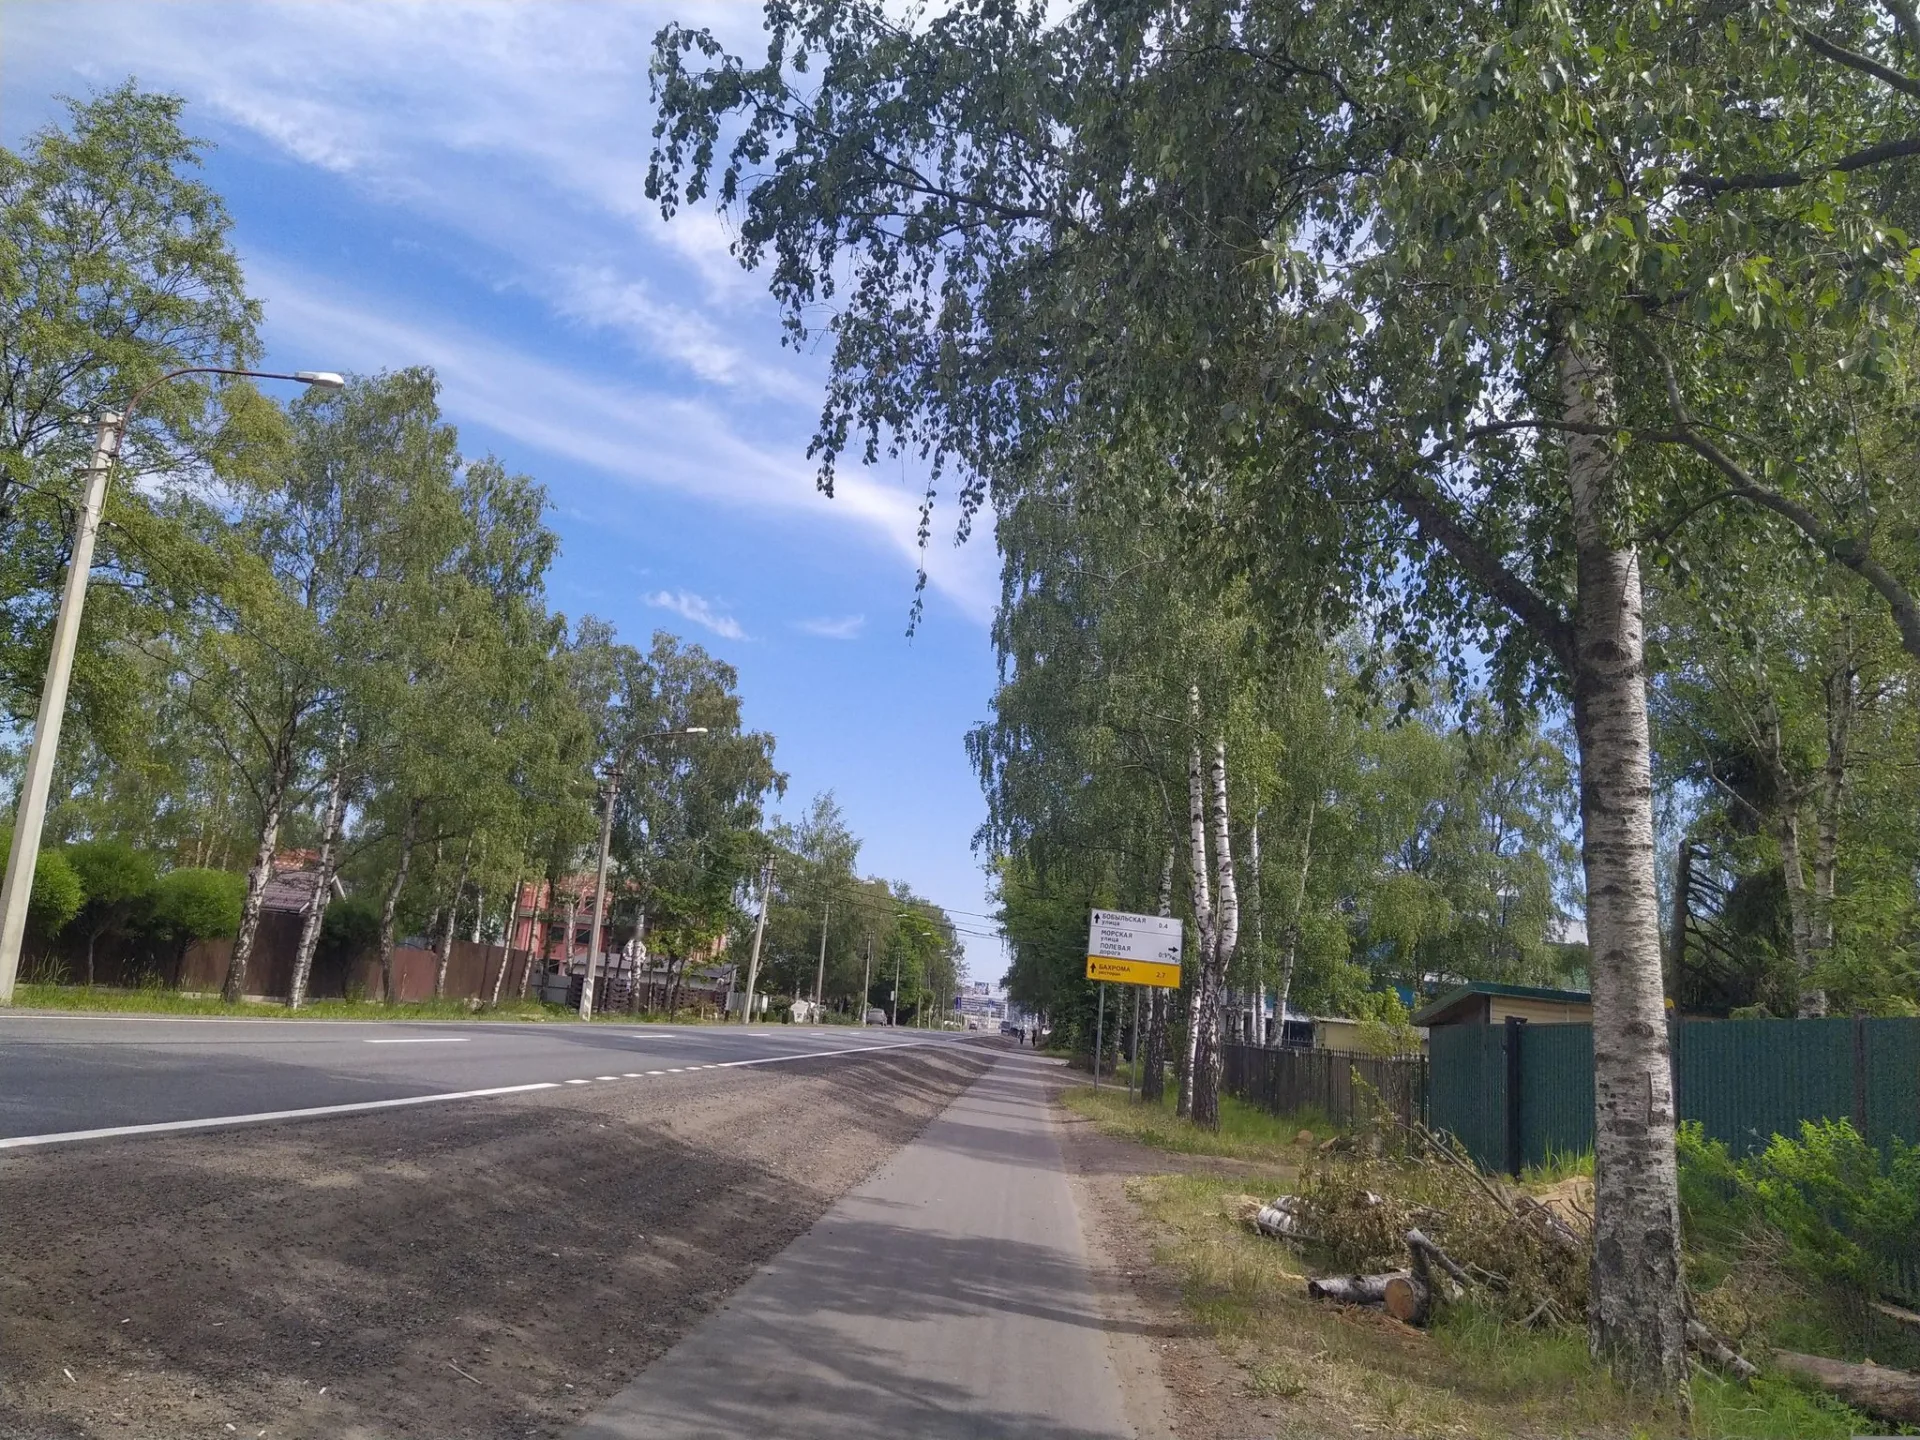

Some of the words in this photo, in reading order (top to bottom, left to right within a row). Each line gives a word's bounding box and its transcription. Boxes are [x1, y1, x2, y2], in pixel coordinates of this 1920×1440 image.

[1102, 913, 1146, 923] БОБЫЛЬСКАЯ
[1101, 930, 1133, 938] МОРСКАЯ
[1100, 943, 1131, 951] ПОЛЕВАЯ
[1099, 964, 1131, 972] БАХРОМА
